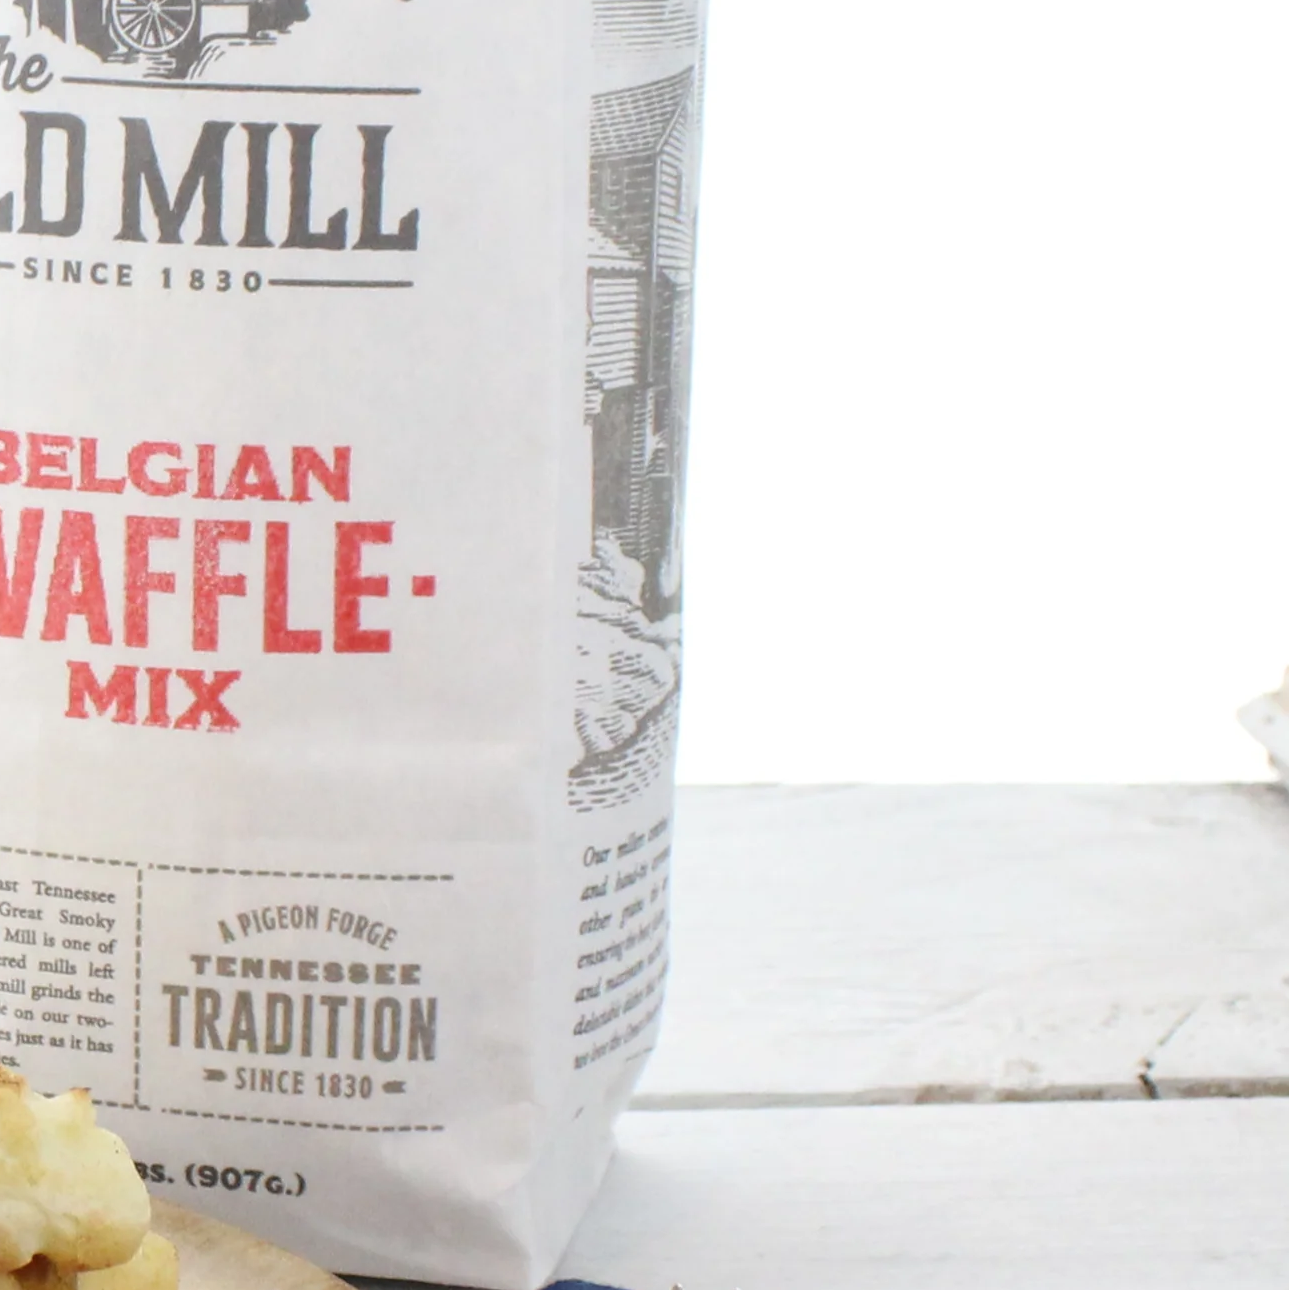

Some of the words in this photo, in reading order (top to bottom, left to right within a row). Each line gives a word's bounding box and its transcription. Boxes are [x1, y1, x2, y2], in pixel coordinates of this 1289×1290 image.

[113, 117, 420, 250] MILL
[23, 256, 133, 288] SINCE
[161, 266, 262, 292] 1830
[65, 660, 242, 733] MIX
[32, 880, 116, 904] Tennessee
[59, 910, 116, 932] Smoky
[218, 920, 236, 944] A
[237, 905, 319, 937] PIGEON
[326, 908, 398, 952] FORGE
[4, 927, 37, 946] Mill
[43, 931, 56, 947] is
[62, 938, 91, 952] one
[98, 938, 117, 954] of
[38, 955, 77, 975] mills
[88, 962, 115, 979] left
[190, 955, 421, 985] TENNESSEE
[31, 983, 81, 1004] grinds
[87, 987, 114, 1005] the
[14, 1006, 34, 1021] on
[42, 1011, 70, 1024] our
[76, 1015, 114, 1029] two-
[161, 984, 437, 1062] TRADITION
[15, 1029, 43, 1047] just
[49, 1037, 65, 1049] as
[70, 1035, 83, 1050] it
[87, 1035, 114, 1054] has
[235, 1067, 304, 1095] SINCE
[316, 1073, 372, 1099] 1830
[133, 1162, 174, 1184] BS.
